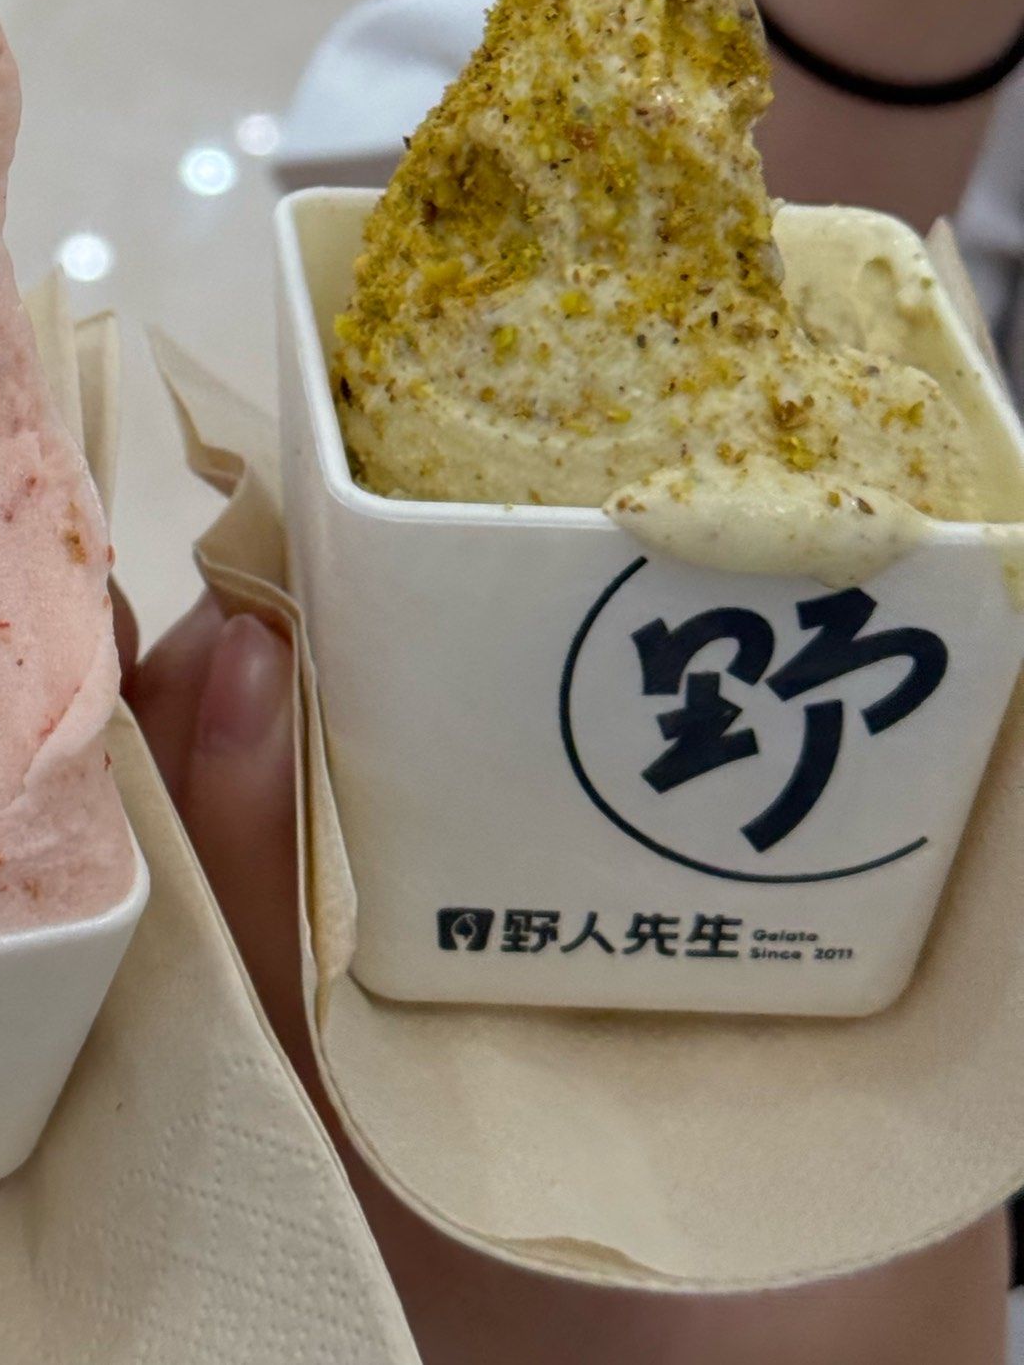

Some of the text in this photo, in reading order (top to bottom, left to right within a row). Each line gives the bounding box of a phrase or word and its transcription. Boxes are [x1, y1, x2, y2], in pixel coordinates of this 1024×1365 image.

[629, 586, 949, 854] 野
[499, 907, 744, 961] 野人先生
[750, 947, 854, 961] Since 2011
